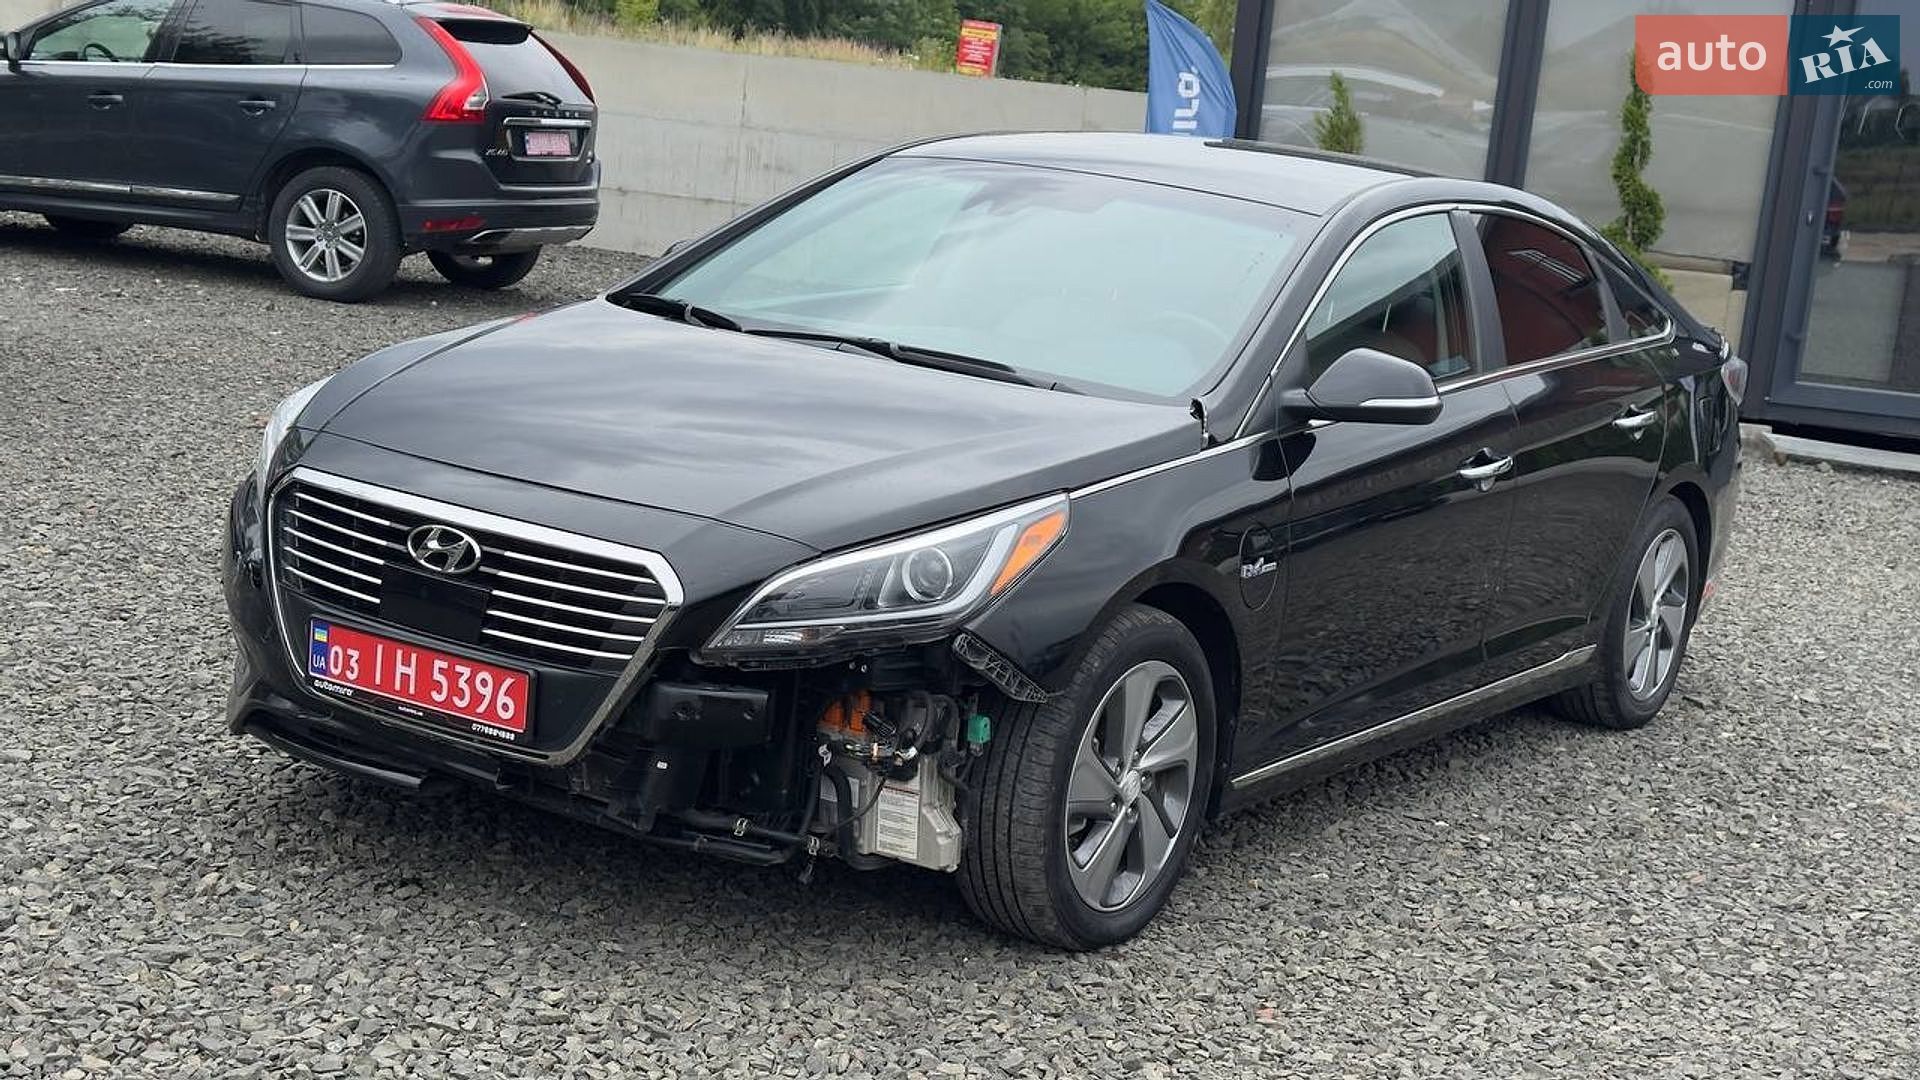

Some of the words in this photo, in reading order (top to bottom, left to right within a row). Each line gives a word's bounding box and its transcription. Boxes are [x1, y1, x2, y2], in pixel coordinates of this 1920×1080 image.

[312, 653, 326, 670] UA
[329, 644, 360, 681] 03
[375, 643, 417, 695] IH
[430, 659, 516, 720] 5396
